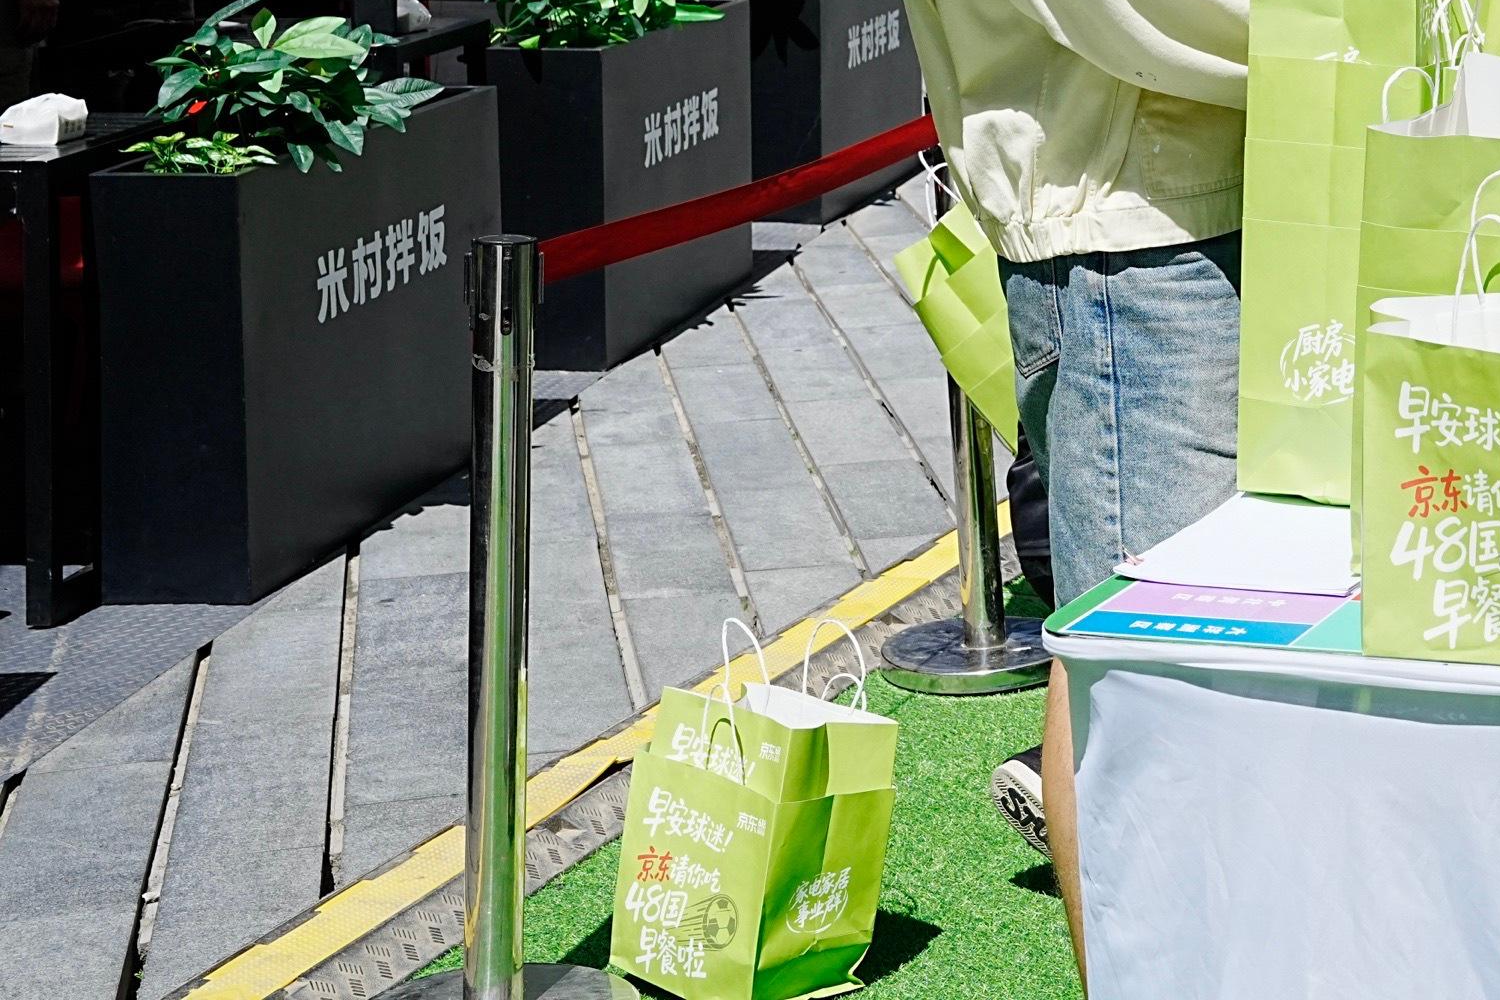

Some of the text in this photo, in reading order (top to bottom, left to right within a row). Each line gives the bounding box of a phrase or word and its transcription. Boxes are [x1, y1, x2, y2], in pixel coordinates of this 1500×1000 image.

[847, 9, 900, 70] 米村拌饭
[644, 87, 719, 169] 米村拌饭
[317, 203, 448, 324] 米村拌饭
[1293, 319, 1344, 364] 厨房
[642, 786, 734, 853] 早安球迷!
[637, 845, 722, 894] 京东请你吃
[625, 882, 690, 929] 48国
[634, 925, 708, 979] 早餐啦
